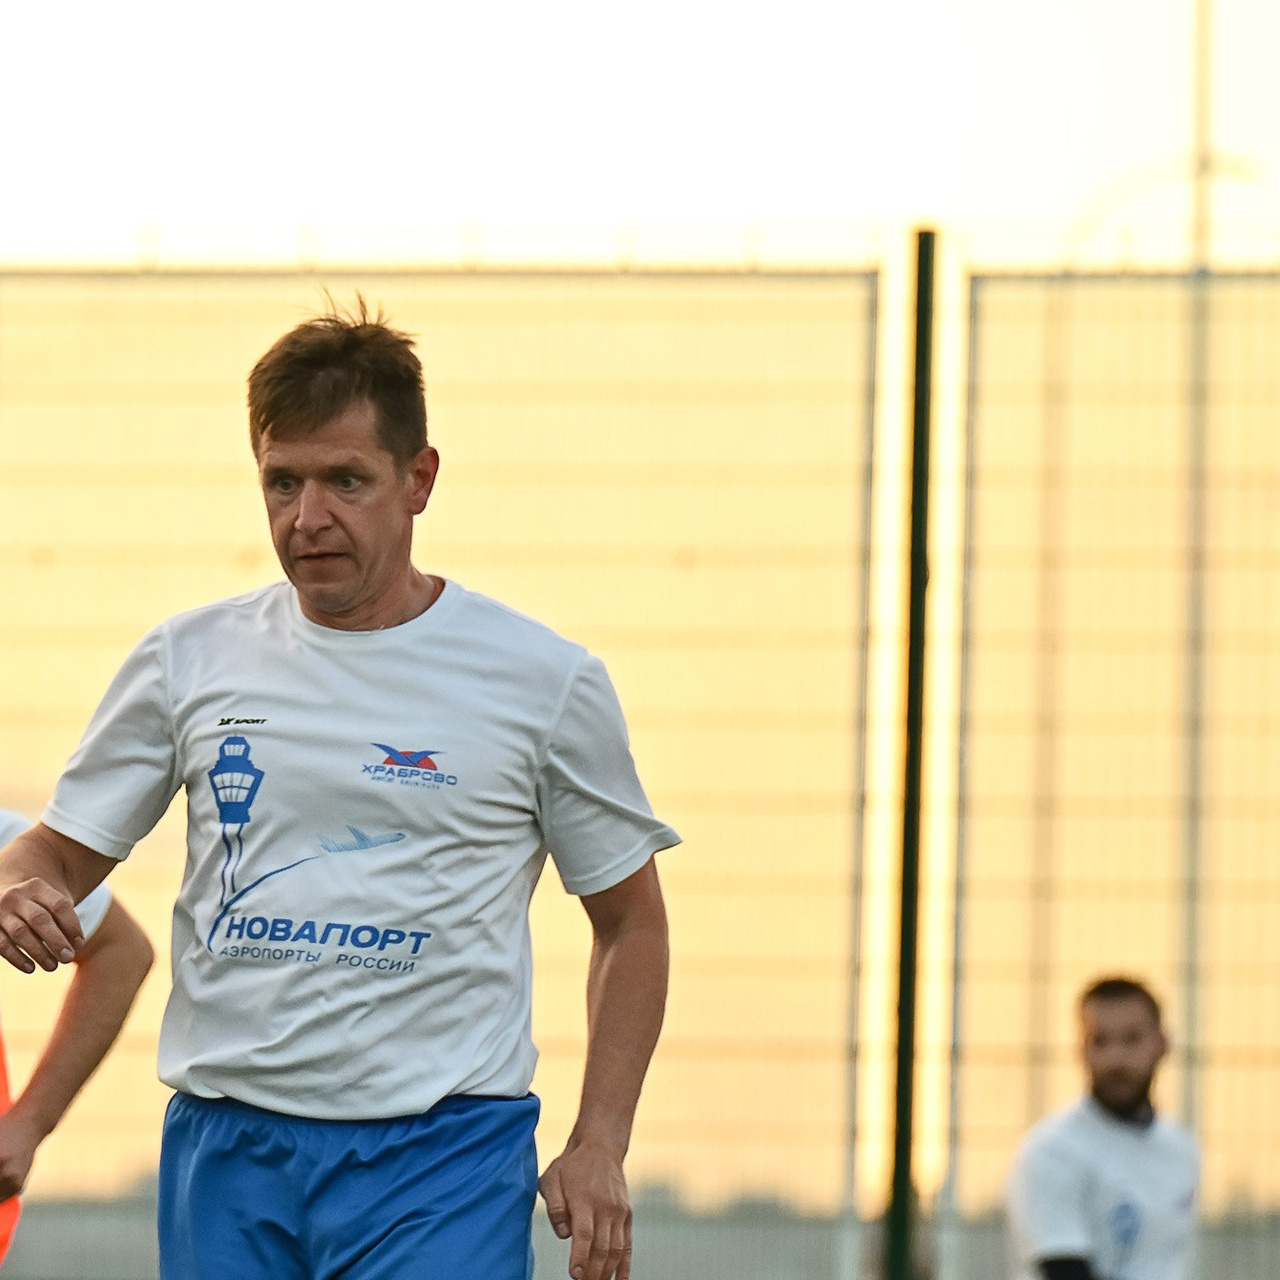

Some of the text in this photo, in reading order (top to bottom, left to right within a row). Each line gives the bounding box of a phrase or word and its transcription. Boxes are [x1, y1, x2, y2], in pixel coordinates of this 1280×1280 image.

[362, 764, 458, 786] ХРАБРОВО
[225, 916, 432, 955] НОВАПОРТ
[220, 946, 416, 972] АЭРОПОРТЫ РОССИИ
